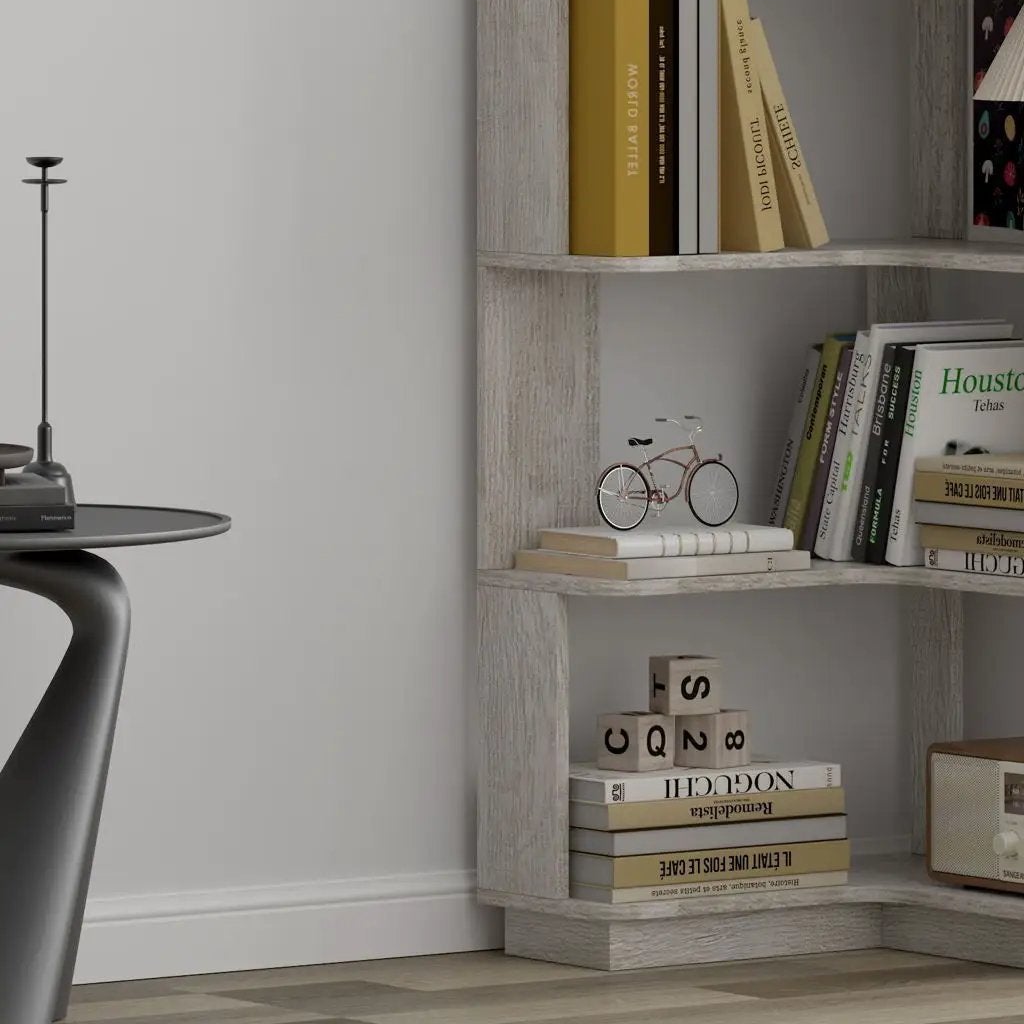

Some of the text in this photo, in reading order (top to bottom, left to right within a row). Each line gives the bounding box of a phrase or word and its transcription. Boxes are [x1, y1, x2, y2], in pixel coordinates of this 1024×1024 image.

[839, 352, 864, 437] Harrisburg
[872, 363, 891, 436] Brisbane
[905, 369, 923, 438] Houston
[974, 399, 1005, 412] Tehas
[819, 371, 843, 463] FORM STYLE
[869, 366, 901, 544] FORMULA FOR SUCCESS
[819, 460, 841, 540] State Capital
[855, 485, 869, 546] Queensland
[680, 675, 710, 700] S
[604, 728, 630, 754] C
[646, 724, 666, 758] Q
[682, 729, 708, 751] 2
[725, 729, 745, 751] 8
[663, 770, 795, 799] NOGUCHI
[690, 802, 773, 820] Remodelista
[659, 851, 792, 881] IL ÉTAIT UNE FOIS LE CAFÉ
